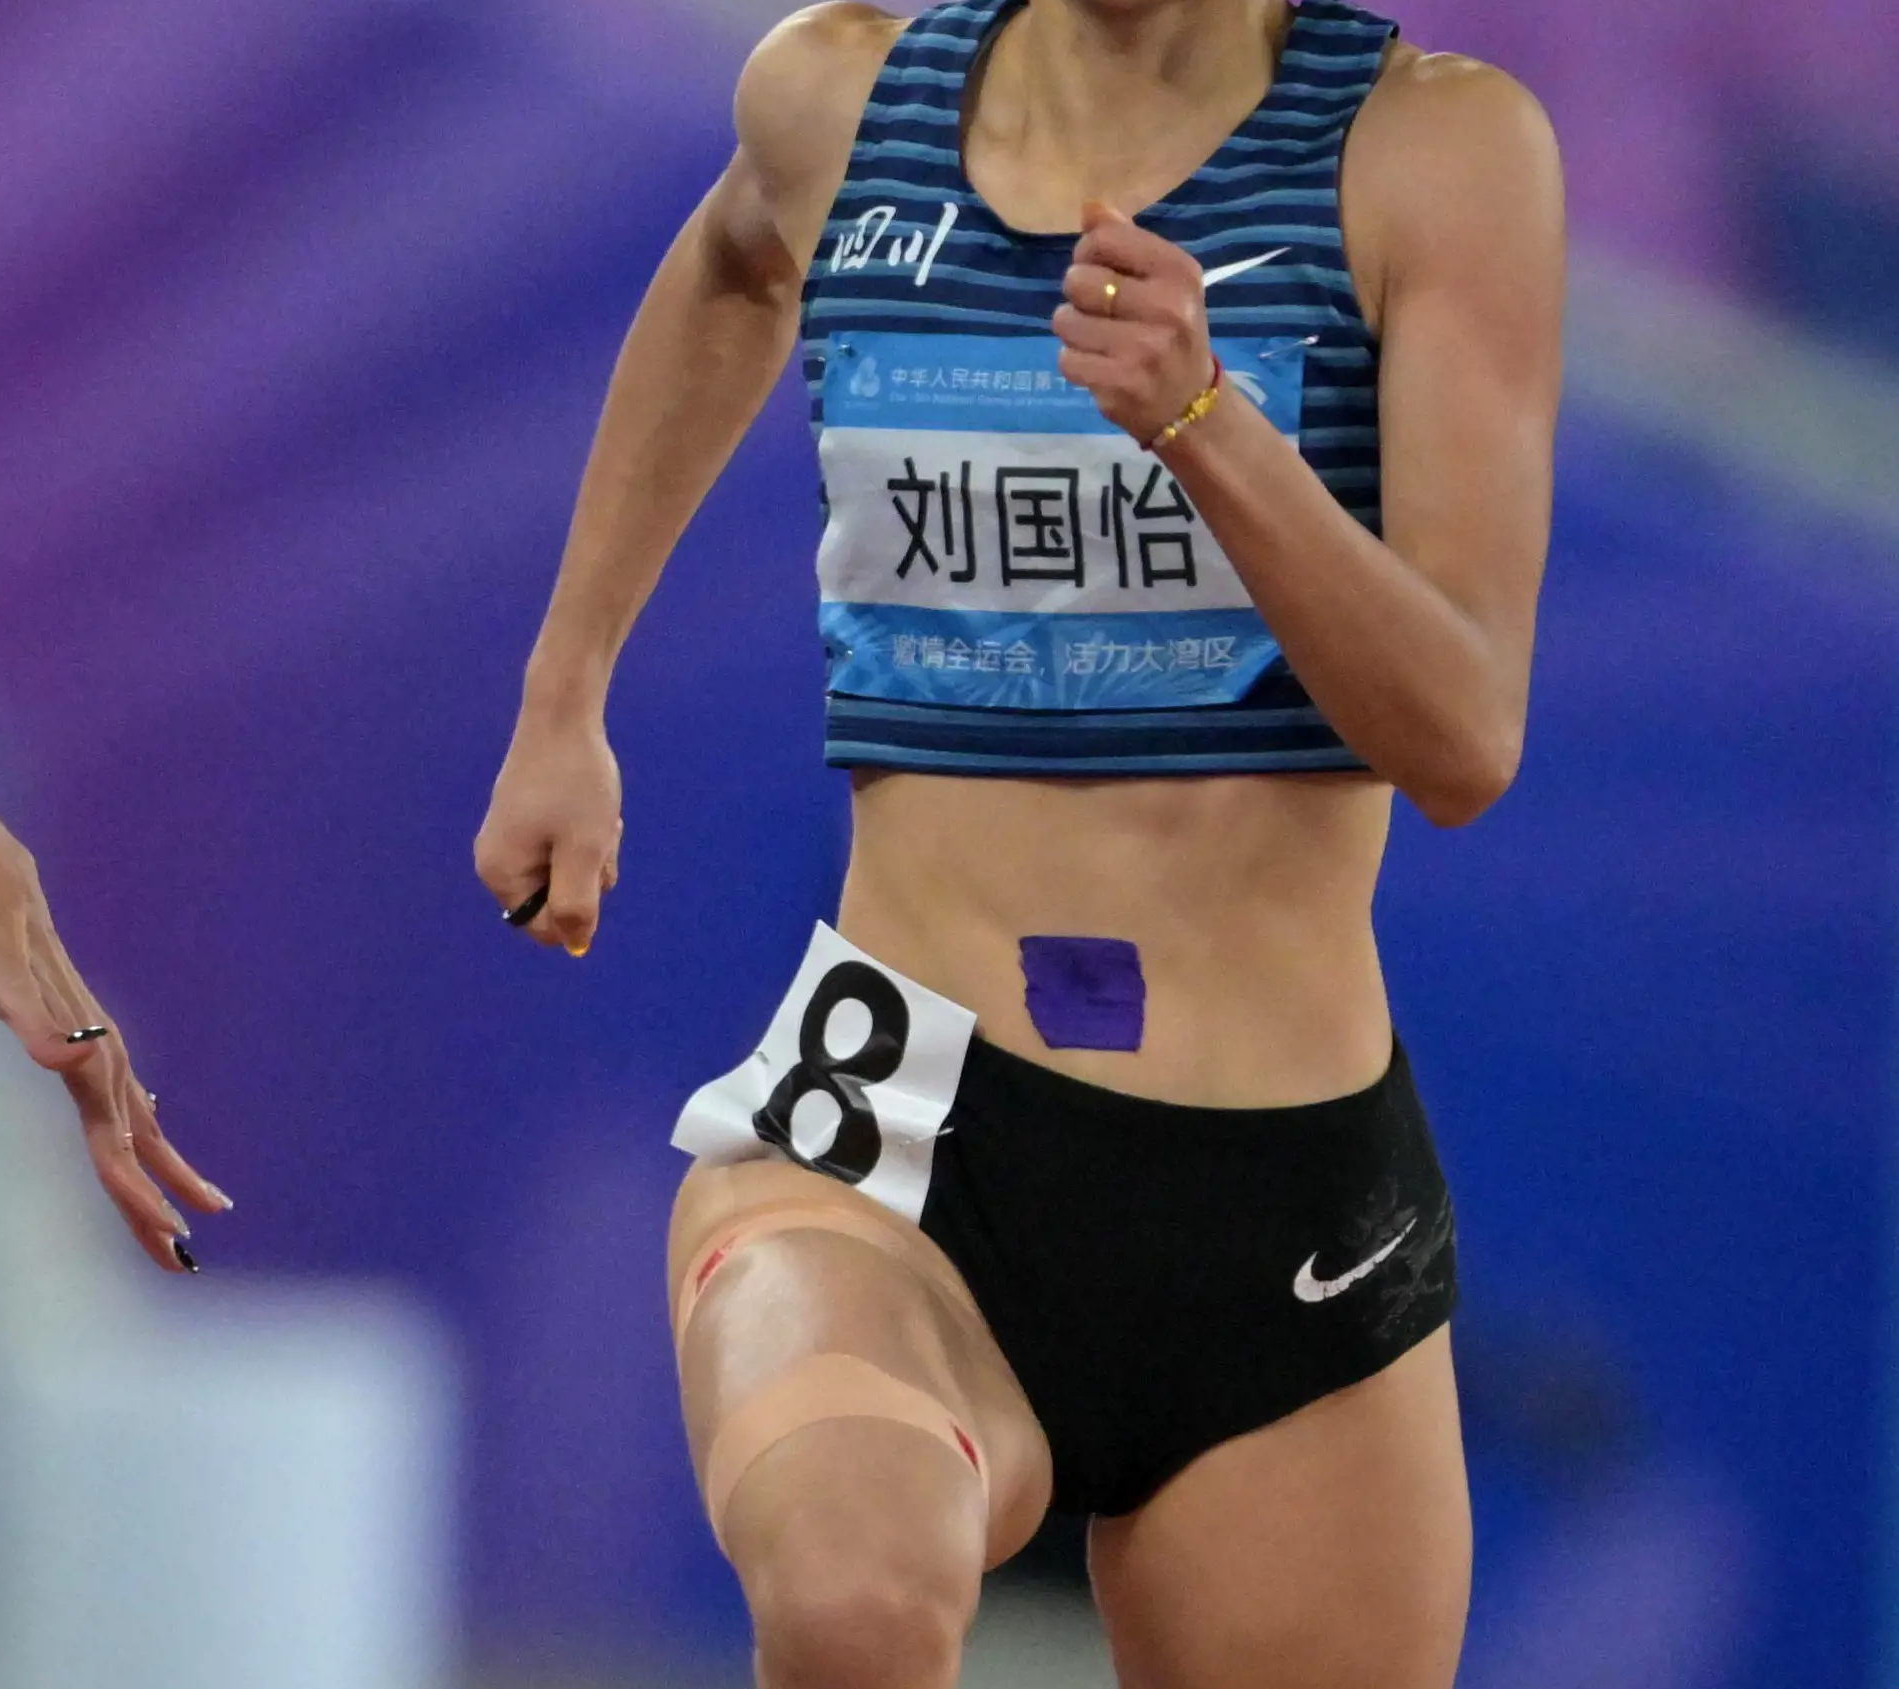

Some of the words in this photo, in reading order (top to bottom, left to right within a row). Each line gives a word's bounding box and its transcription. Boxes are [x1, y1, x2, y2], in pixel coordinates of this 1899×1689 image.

[886, 455, 1198, 590] 刘国怡
[752, 959, 911, 1186] 8
